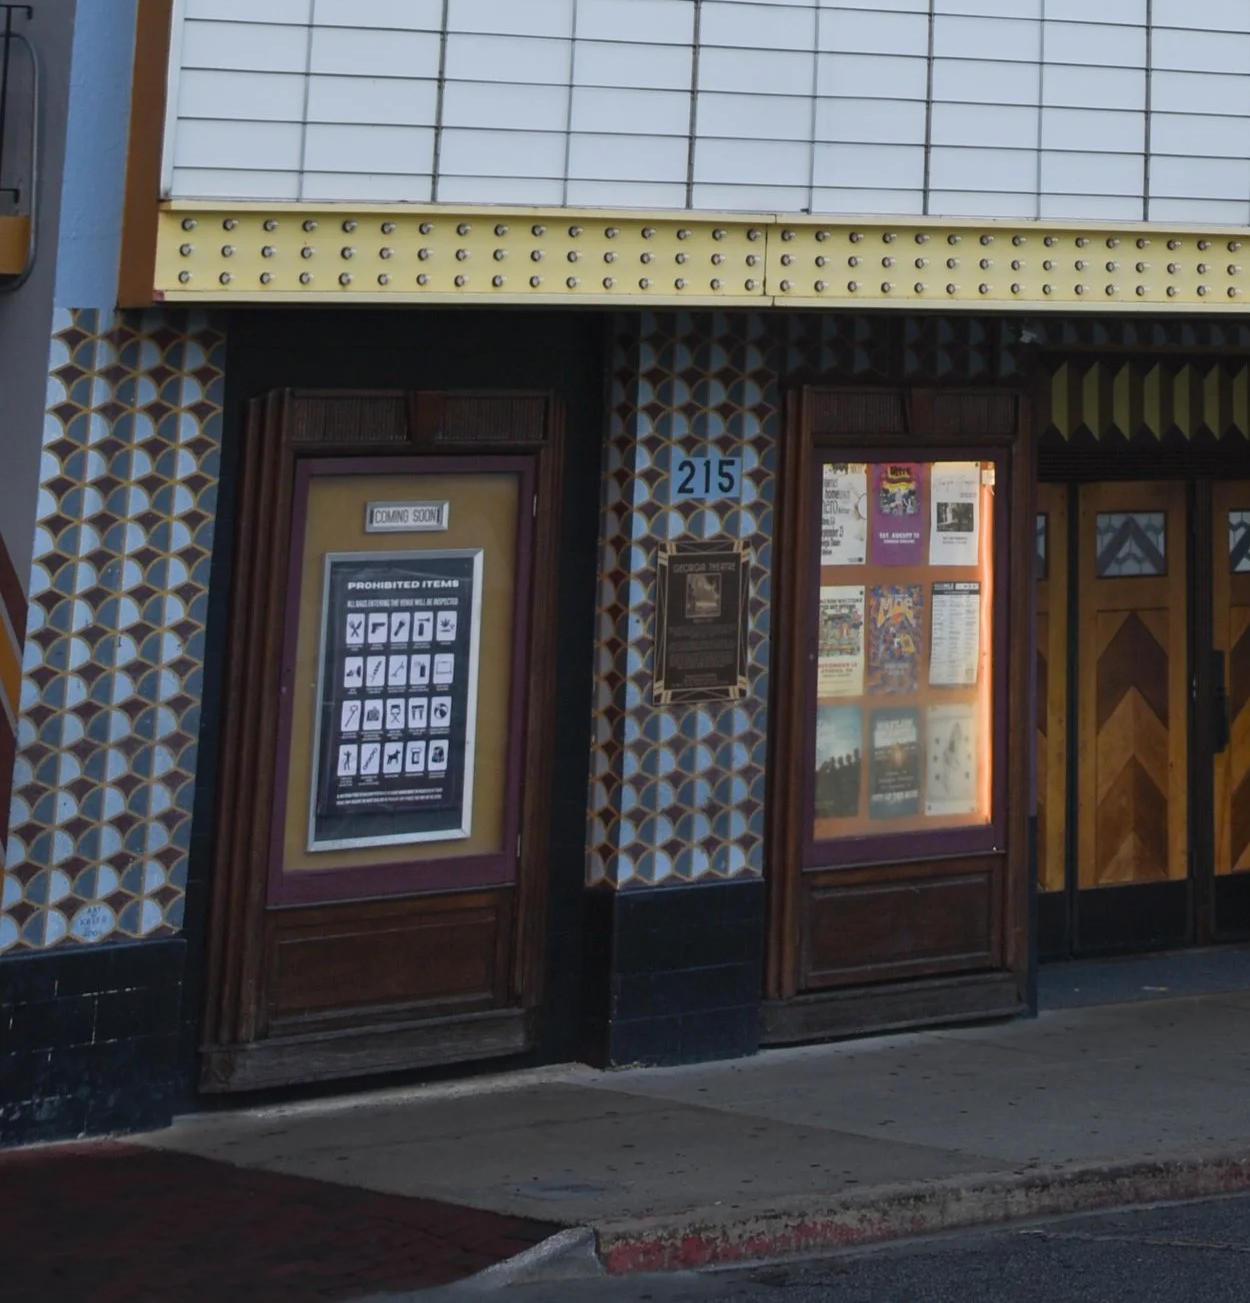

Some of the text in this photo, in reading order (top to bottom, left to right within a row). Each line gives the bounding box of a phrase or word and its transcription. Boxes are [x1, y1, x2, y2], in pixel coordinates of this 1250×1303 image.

[677, 459, 736, 494] 215
[374, 509, 438, 524] COMING SOON
[673, 560, 736, 573] GEORGIA THEATRE
[347, 579, 460, 590] PROHIBITED ITEMS
